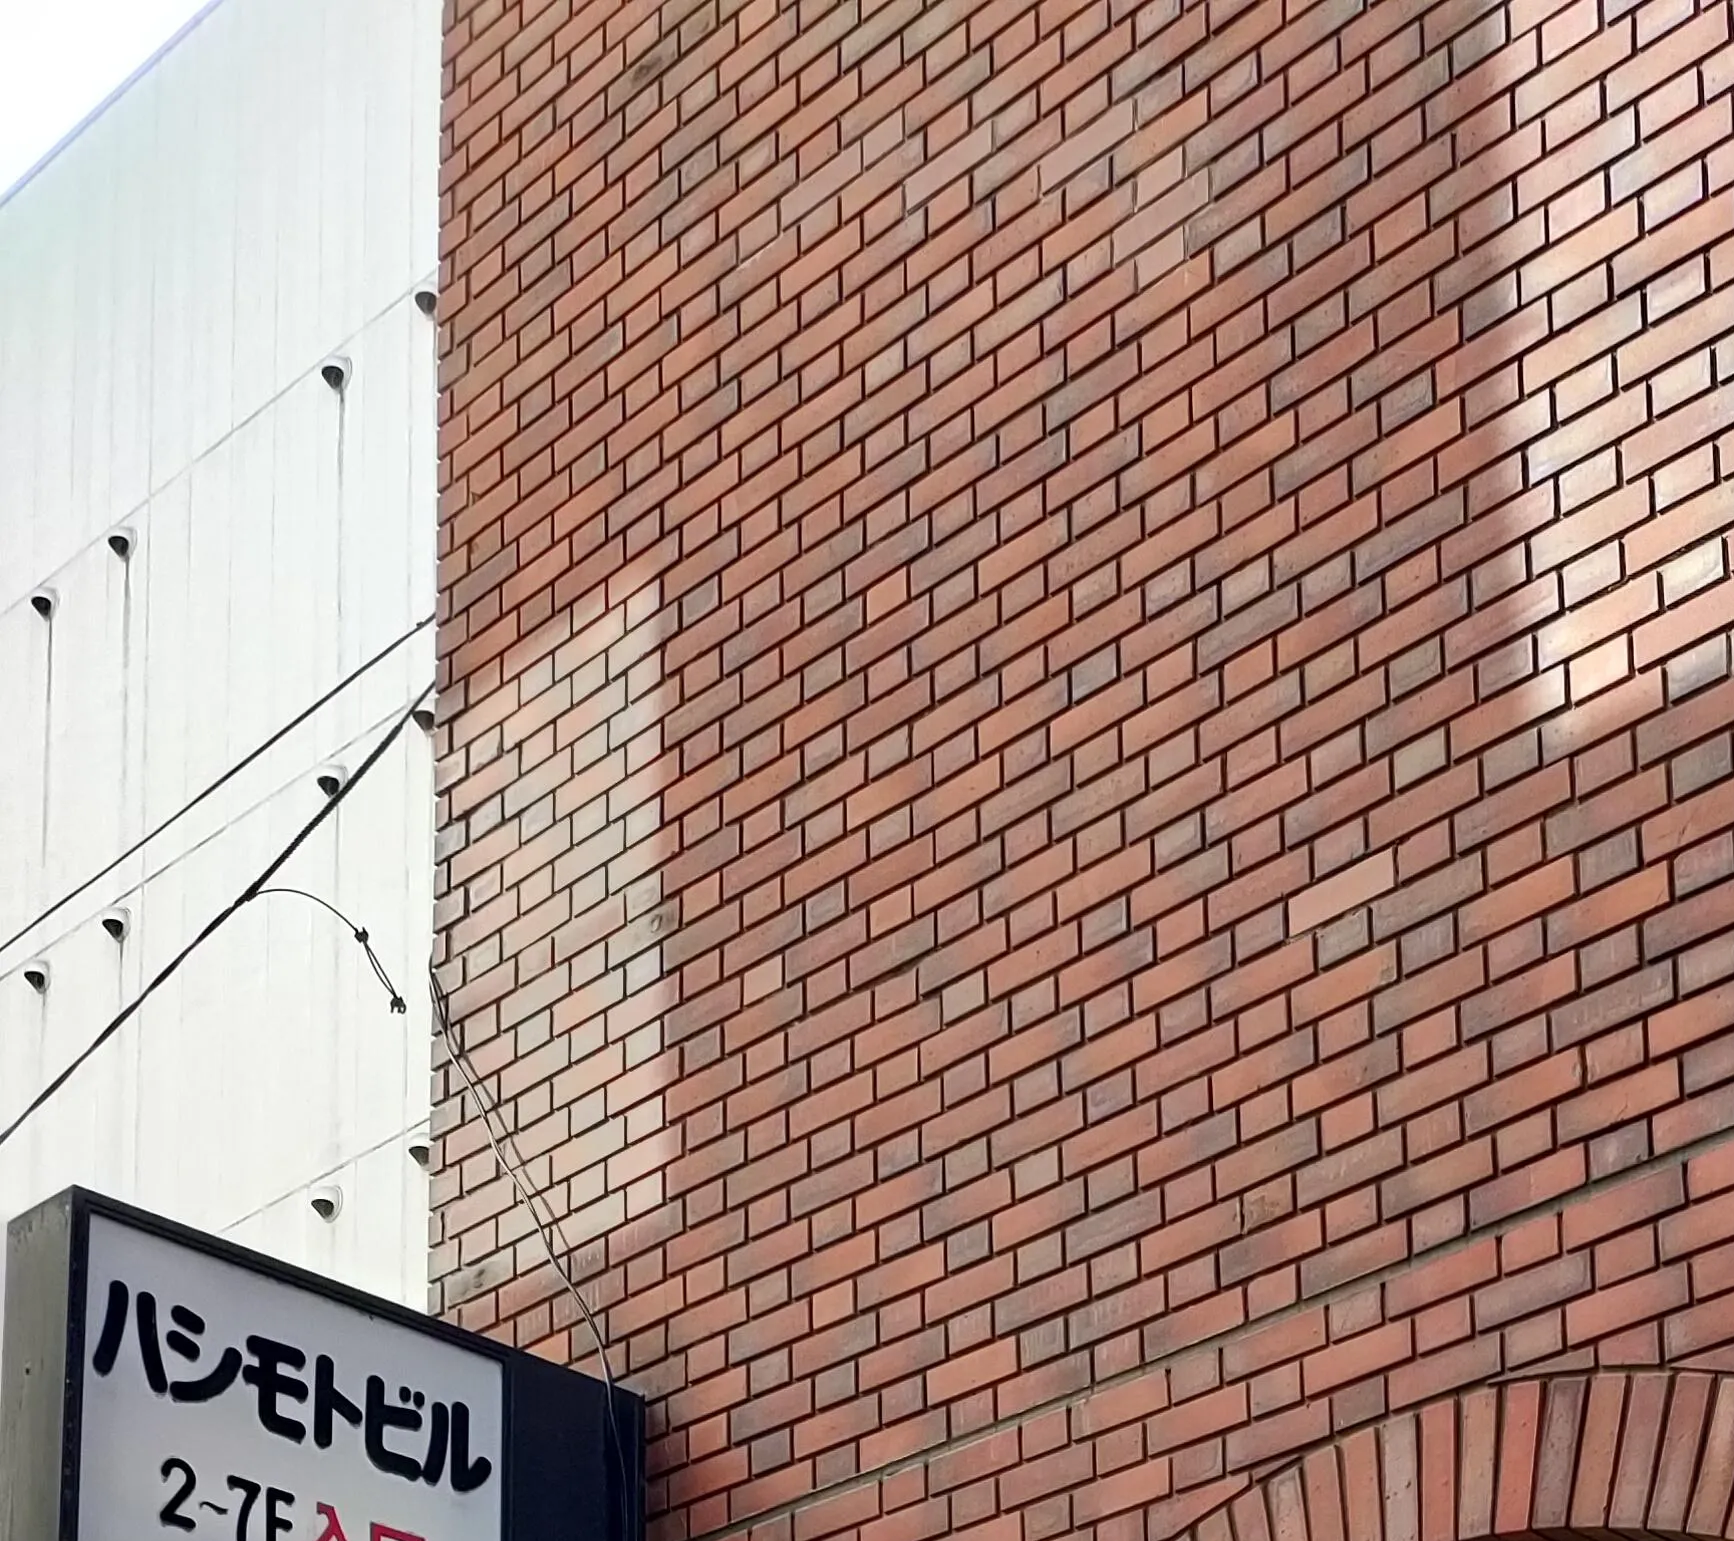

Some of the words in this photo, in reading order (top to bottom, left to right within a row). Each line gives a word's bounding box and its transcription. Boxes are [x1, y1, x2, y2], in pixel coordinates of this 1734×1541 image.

[92, 1279, 492, 1493] ハシモトビル
